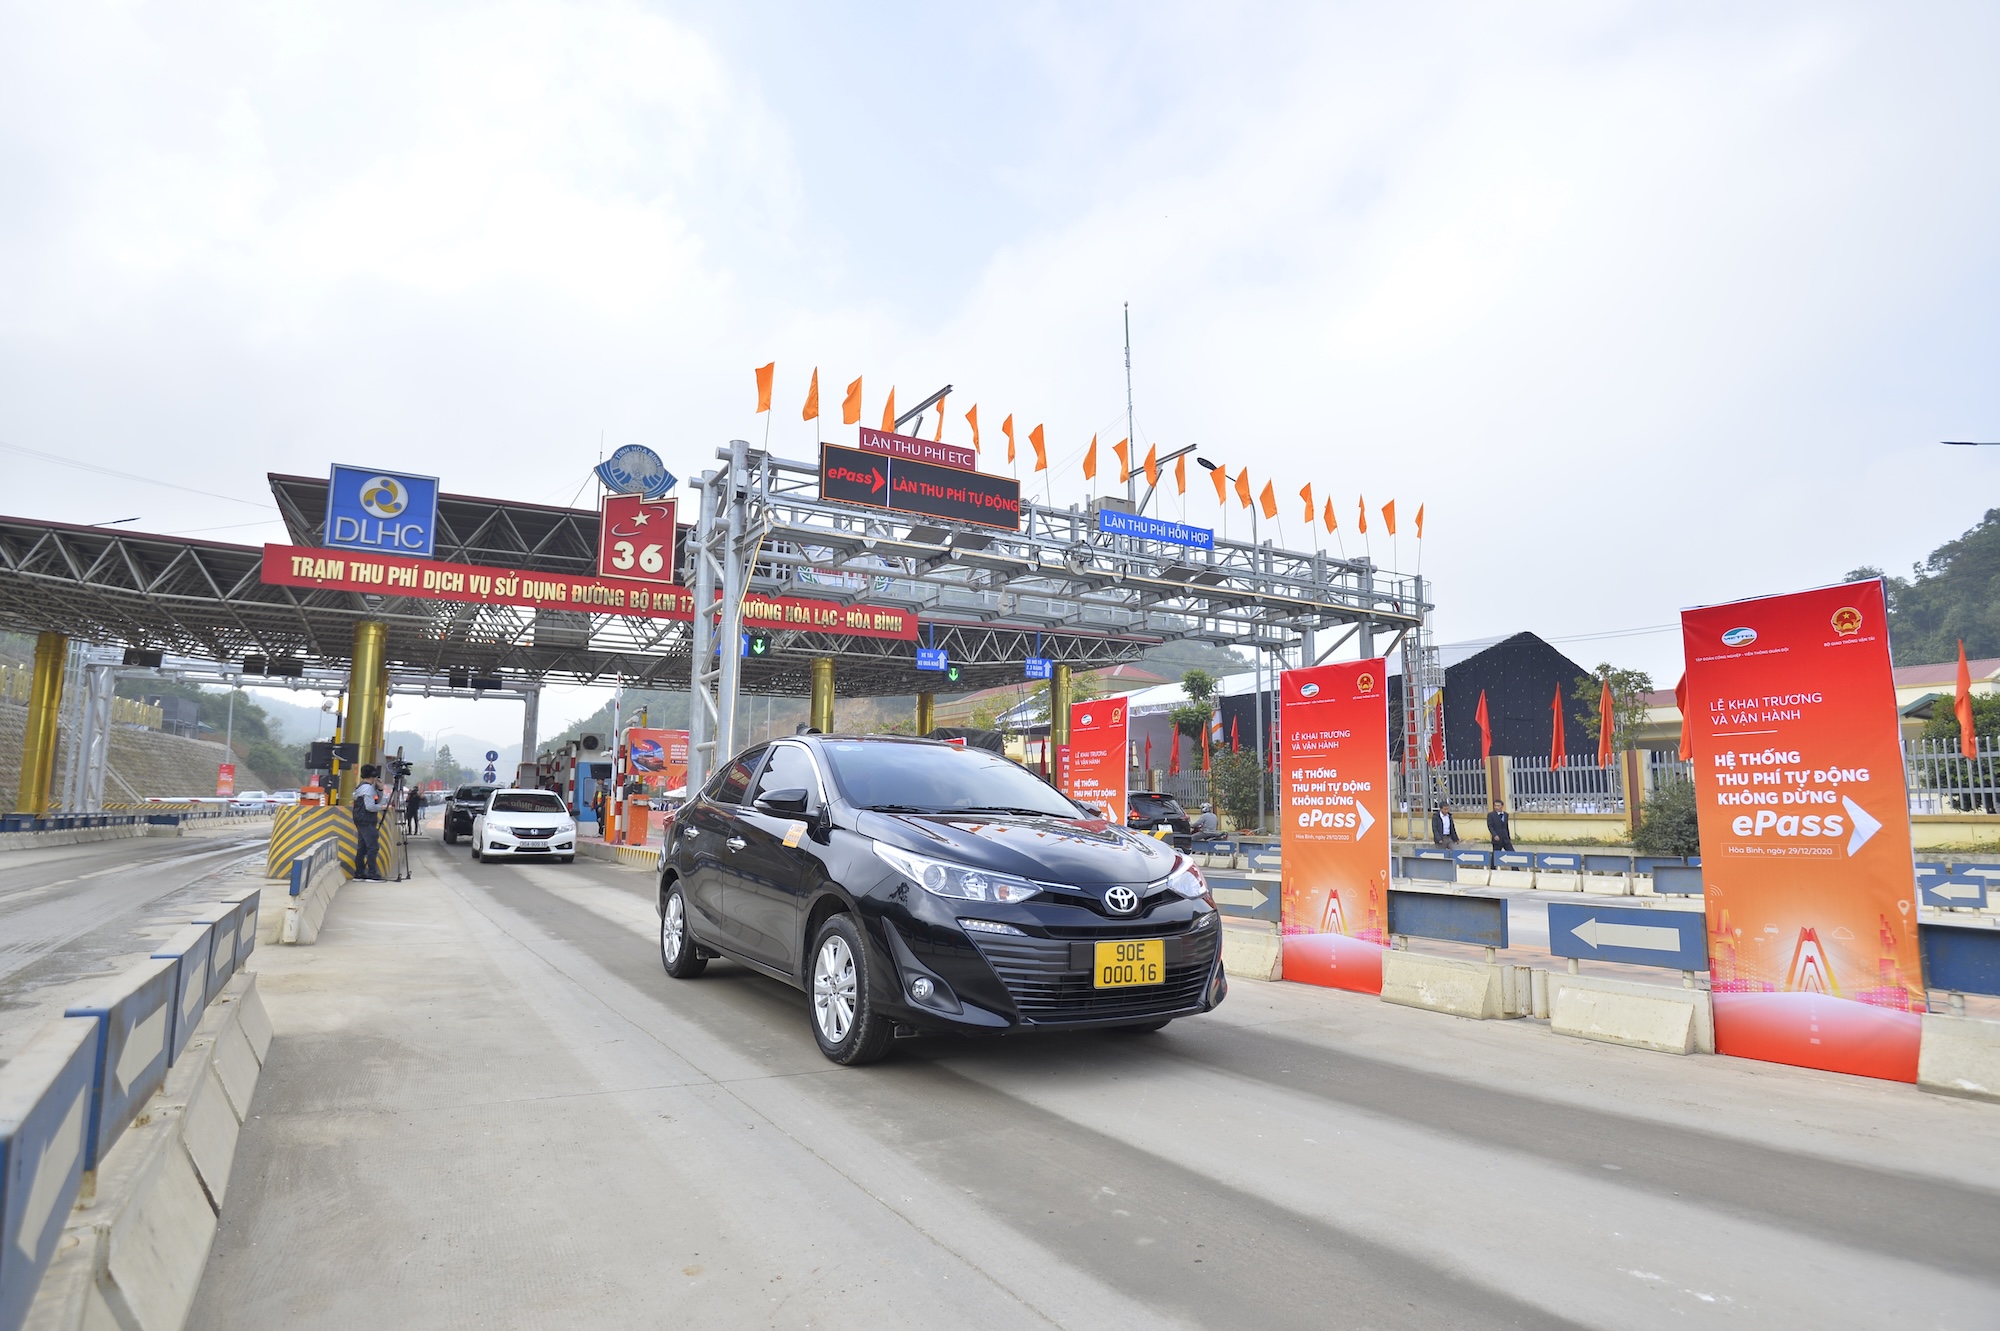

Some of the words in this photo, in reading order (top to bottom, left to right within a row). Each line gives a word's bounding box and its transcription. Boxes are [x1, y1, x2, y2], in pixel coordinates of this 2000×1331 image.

[864, 432, 890, 450] LÀN
[894, 440, 920, 456] THU
[925, 446, 945, 461] PHÍ
[950, 451, 971, 466] ETC
[828, 467, 872, 485] ePass
[893, 476, 917, 494] LÀN
[920, 483, 944, 498] THU
[947, 487, 966, 502] PHÍ
[968, 492, 984, 508] TỰ
[985, 494, 1018, 513] ĐỘNG
[335, 516, 424, 549] DLHC
[1104, 514, 1125, 529] LÀN
[1128, 519, 1148, 533] THU
[1150, 523, 1166, 536] PHÍ
[1168, 524, 1188, 540] HỖN
[1191, 532, 1209, 545] HỢP
[611, 540, 664, 574] 36
[291, 556, 345, 583] TRẠM
[350, 562, 384, 584] THU
[388, 565, 419, 588] PHÍ
[423, 570, 464, 594] DỊCH
[469, 574, 491, 598] VỤ
[495, 571, 520, 597] SỬ
[522, 580, 566, 603] DỤNG
[572, 582, 625, 607] ĐƯỜNG
[630, 588, 649, 612] BỘ
[653, 592, 676, 611] KM
[785, 602, 810, 624] HÒA
[814, 608, 838, 628] LẠC
[846, 608, 870, 630] HÒA
[874, 611, 903, 632] BÌNH
[1710, 697, 1725, 712] LỄ
[1728, 698, 1759, 710] KHAI
[1762, 692, 1823, 707] TRƯƠNG
[1711, 711, 1728, 725] VÀ
[1731, 711, 1758, 727] VẬN
[1761, 708, 1801, 722] HÀNH
[1291, 732, 1300, 741] LỄ
[1301, 732, 1318, 740] KHAI
[1319, 730, 1351, 739] TRƯƠNG
[1291, 741, 1300, 750] VÀ
[1302, 742, 1317, 752] VẬN
[1318, 739, 1339, 749] HÀNH
[1714, 750, 1735, 770] HỆ
[1740, 748, 1800, 765] THỐNG
[1292, 768, 1303, 781] HỆ
[1305, 767, 1337, 779] THỐNG
[1716, 772, 1749, 786] THU
[1753, 768, 1781, 785] PHÍ
[1784, 770, 1811, 787] TỰ
[1814, 767, 1870, 786] ĐỘNG
[1292, 783, 1309, 792] THU
[1311, 781, 1326, 792] PHÍ
[1328, 782, 1341, 794] TỰ
[1342, 780, 1370, 793] ĐỘNG
[1718, 790, 1778, 806] KHÔNG
[1782, 788, 1837, 804] DỪNG
[1292, 794, 1324, 806] KHÔNG
[1326, 793, 1353, 805] DỪNG
[1298, 808, 1356, 828] ePass
[1732, 810, 1844, 837] ePass
[1728, 846, 1745, 854] Hòa
[1746, 846, 1765, 856] Bình,
[1767, 847, 1786, 857] ngày
[1788, 847, 1832, 855] 29/12/2020
[1116, 943, 1145, 962] 90E
[1104, 964, 1156, 984] 000.16
